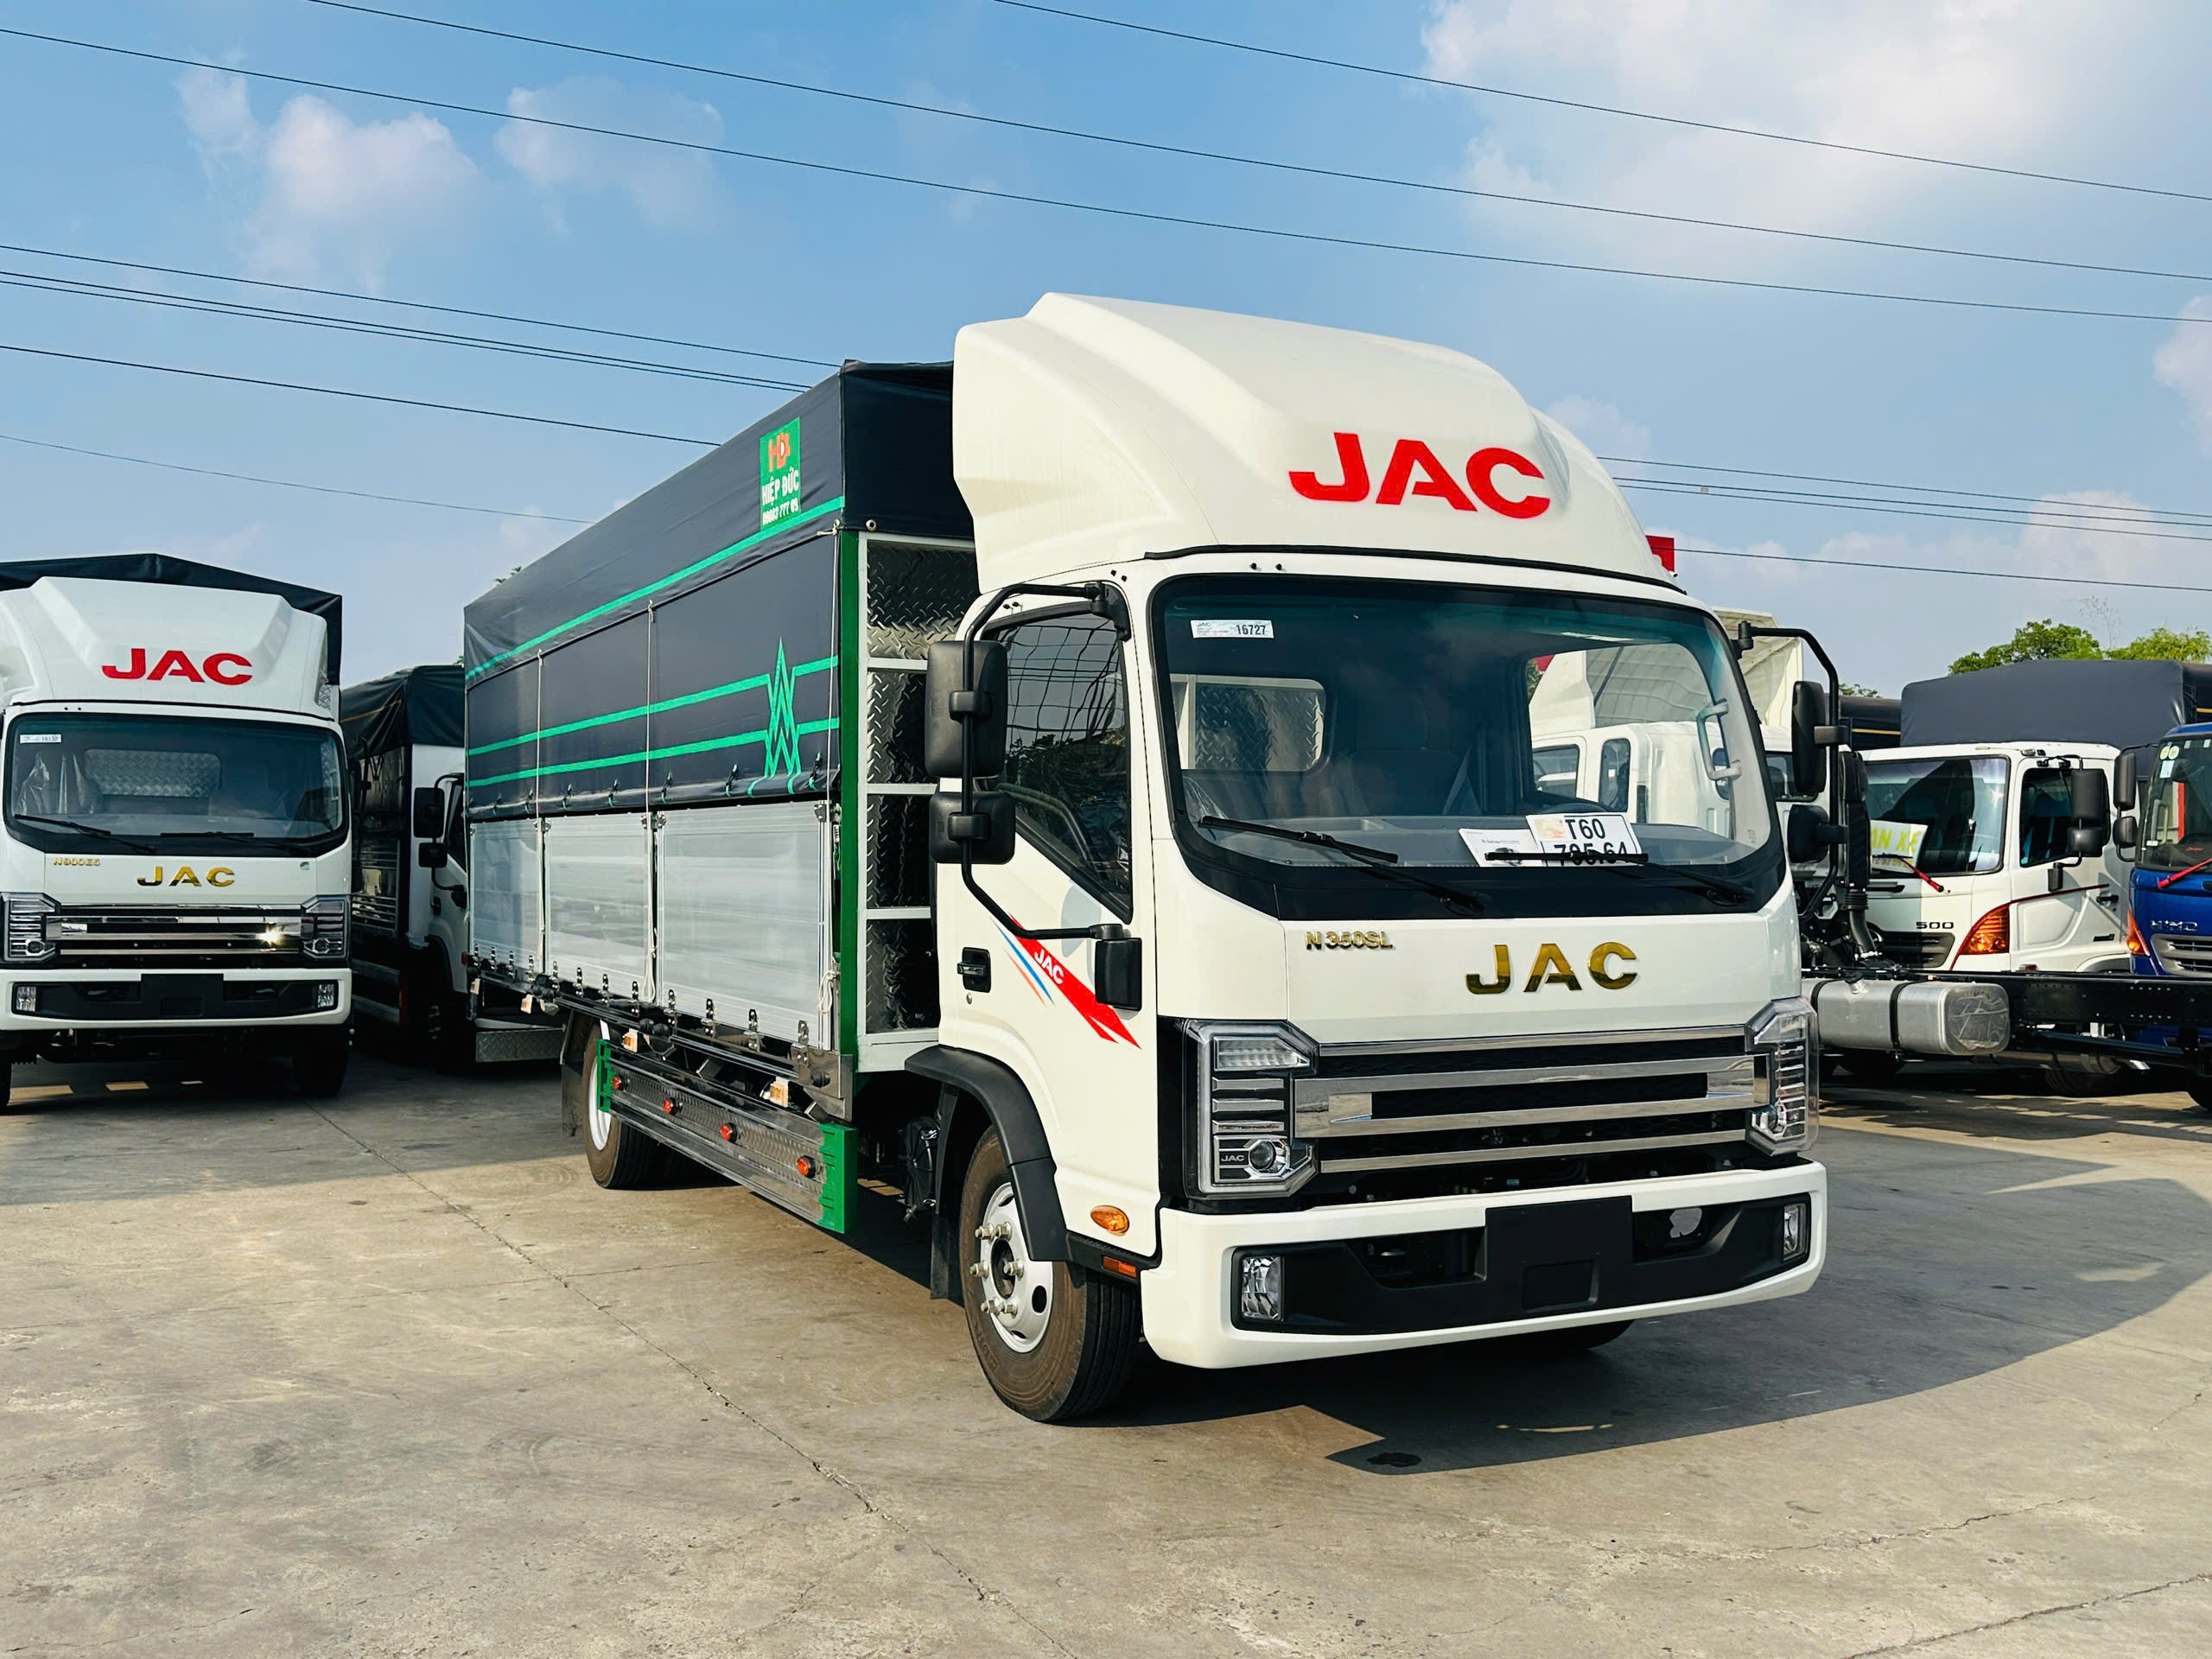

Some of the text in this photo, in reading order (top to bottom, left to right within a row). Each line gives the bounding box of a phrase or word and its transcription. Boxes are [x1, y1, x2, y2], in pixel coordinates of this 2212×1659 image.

[1288, 432, 1551, 519] JAC
[1236, 624, 1266, 635] 16727
[101, 648, 253, 685] JAC
[1565, 818, 1605, 840] T60
[137, 866, 236, 887] JAC
[1916, 921, 1954, 930] 500
[1033, 949, 1065, 984] JAC
[1465, 941, 1638, 995] JAC
[1221, 1154, 1245, 1162] JAC
